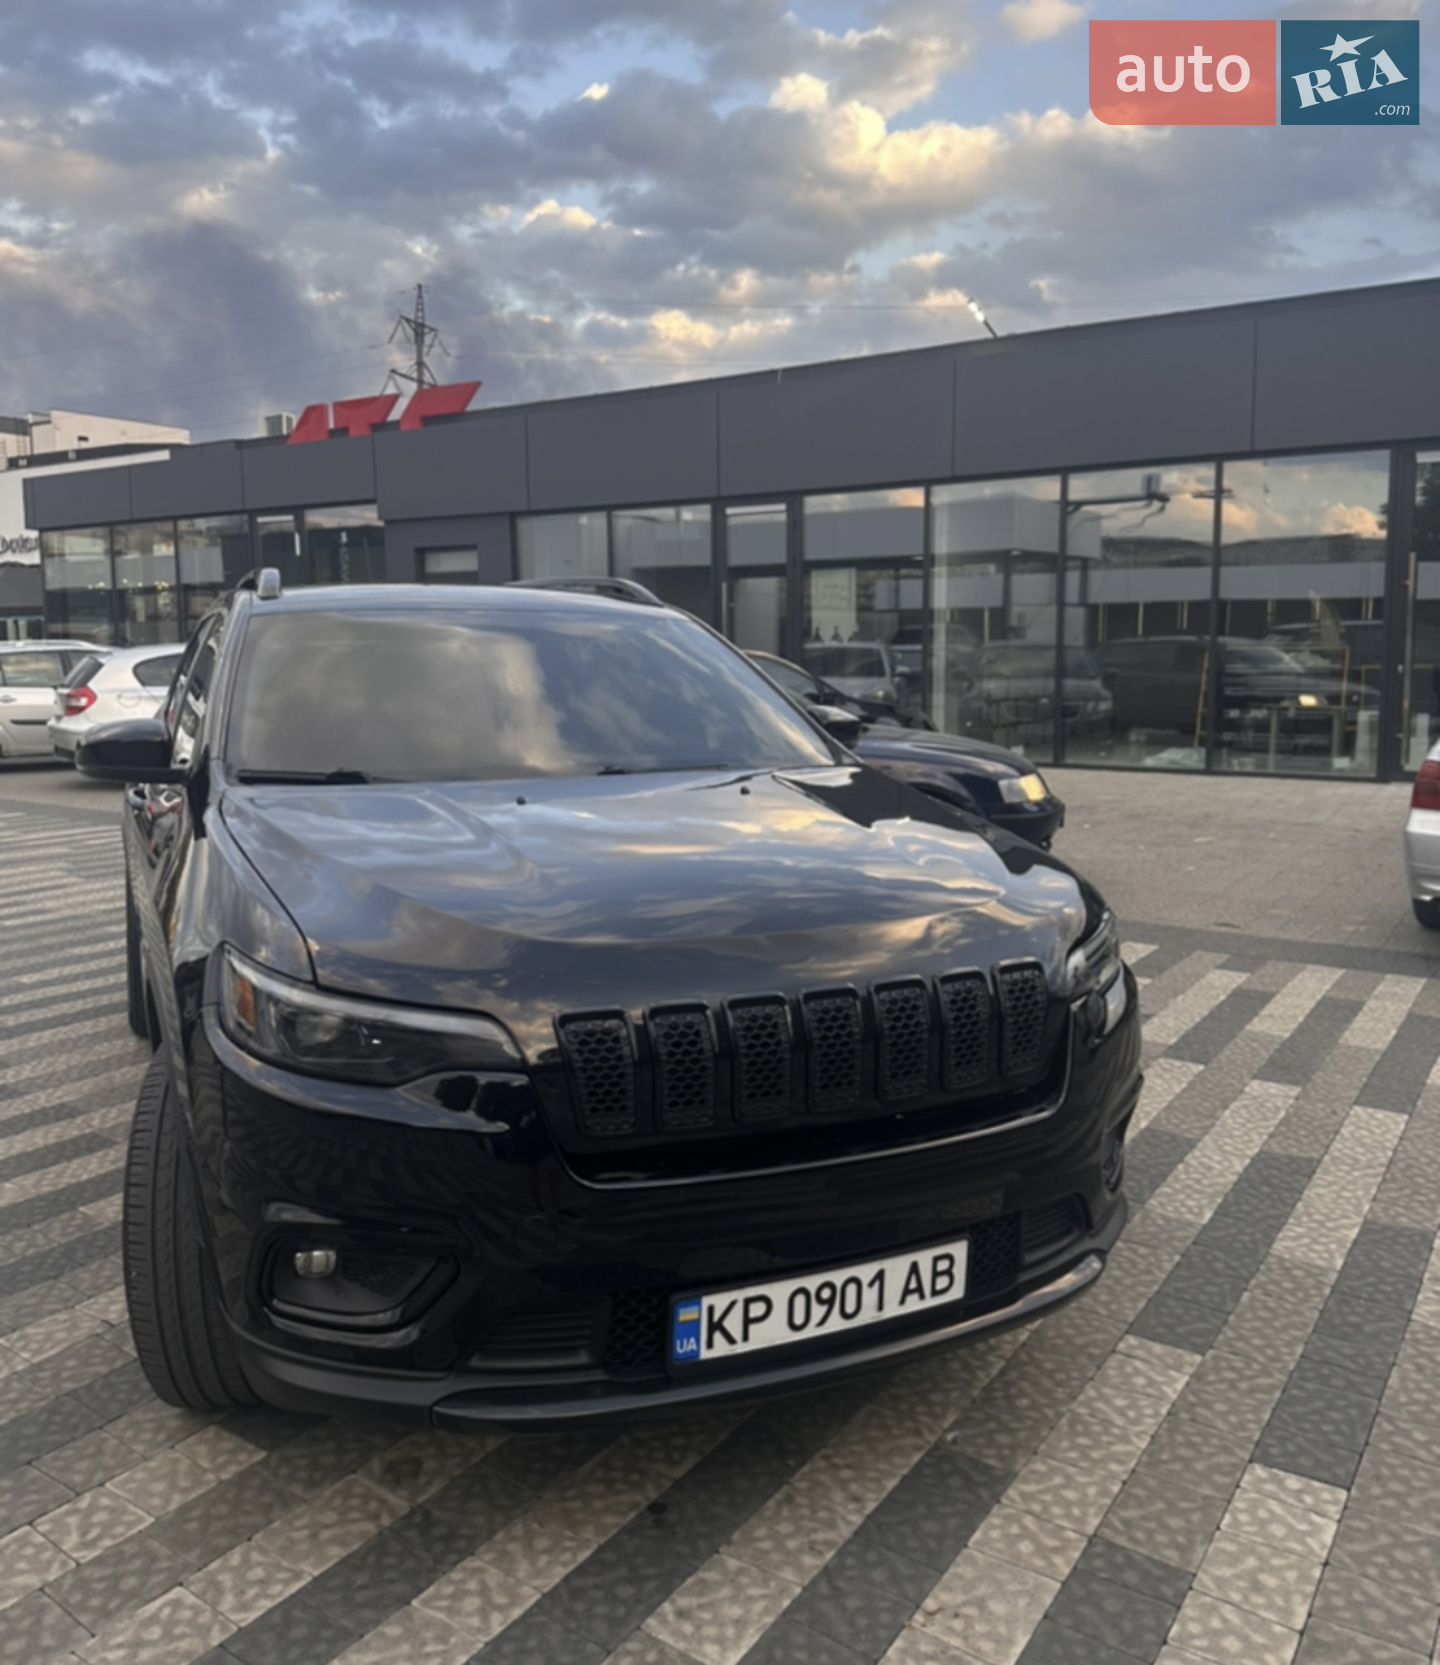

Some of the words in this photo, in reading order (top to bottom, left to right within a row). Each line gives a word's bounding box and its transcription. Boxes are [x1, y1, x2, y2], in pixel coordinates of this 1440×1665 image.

[705, 1294, 773, 1350] KP
[787, 1268, 886, 1332] 0901
[899, 1252, 955, 1306] AB
[676, 1337, 698, 1354] UA
